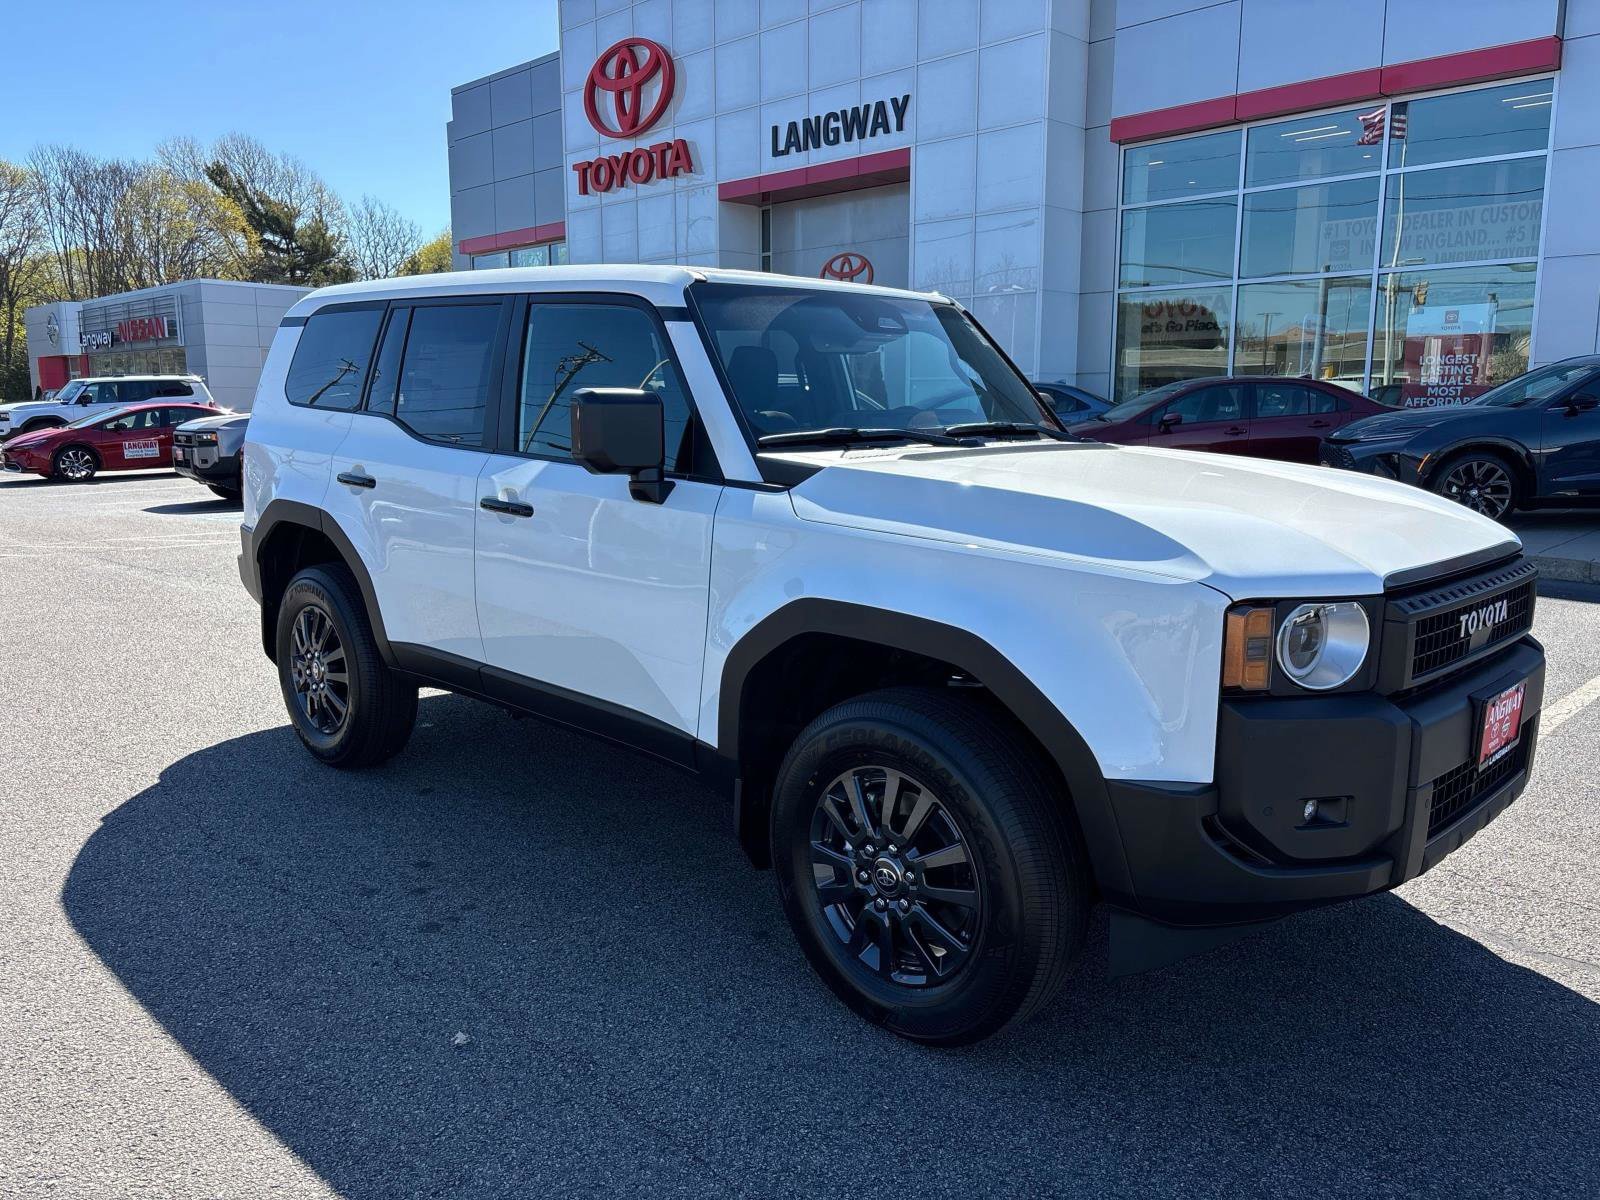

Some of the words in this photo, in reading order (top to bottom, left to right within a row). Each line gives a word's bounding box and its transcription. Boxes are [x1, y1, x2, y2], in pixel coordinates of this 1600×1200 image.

[771, 94, 911, 158] LANGWAY
[572, 138, 693, 196] TOYOTA
[1403, 210, 1454, 231] DEALER
[1456, 208, 1475, 227] IN
[118, 316, 169, 343] NISSAN
[1419, 353, 1478, 365] LONGEST
[1420, 365, 1473, 376] LASTING
[1420, 375, 1472, 386] EQUALS
[1427, 386, 1464, 397] MOST
[1459, 599, 1508, 638] TOYOTA
